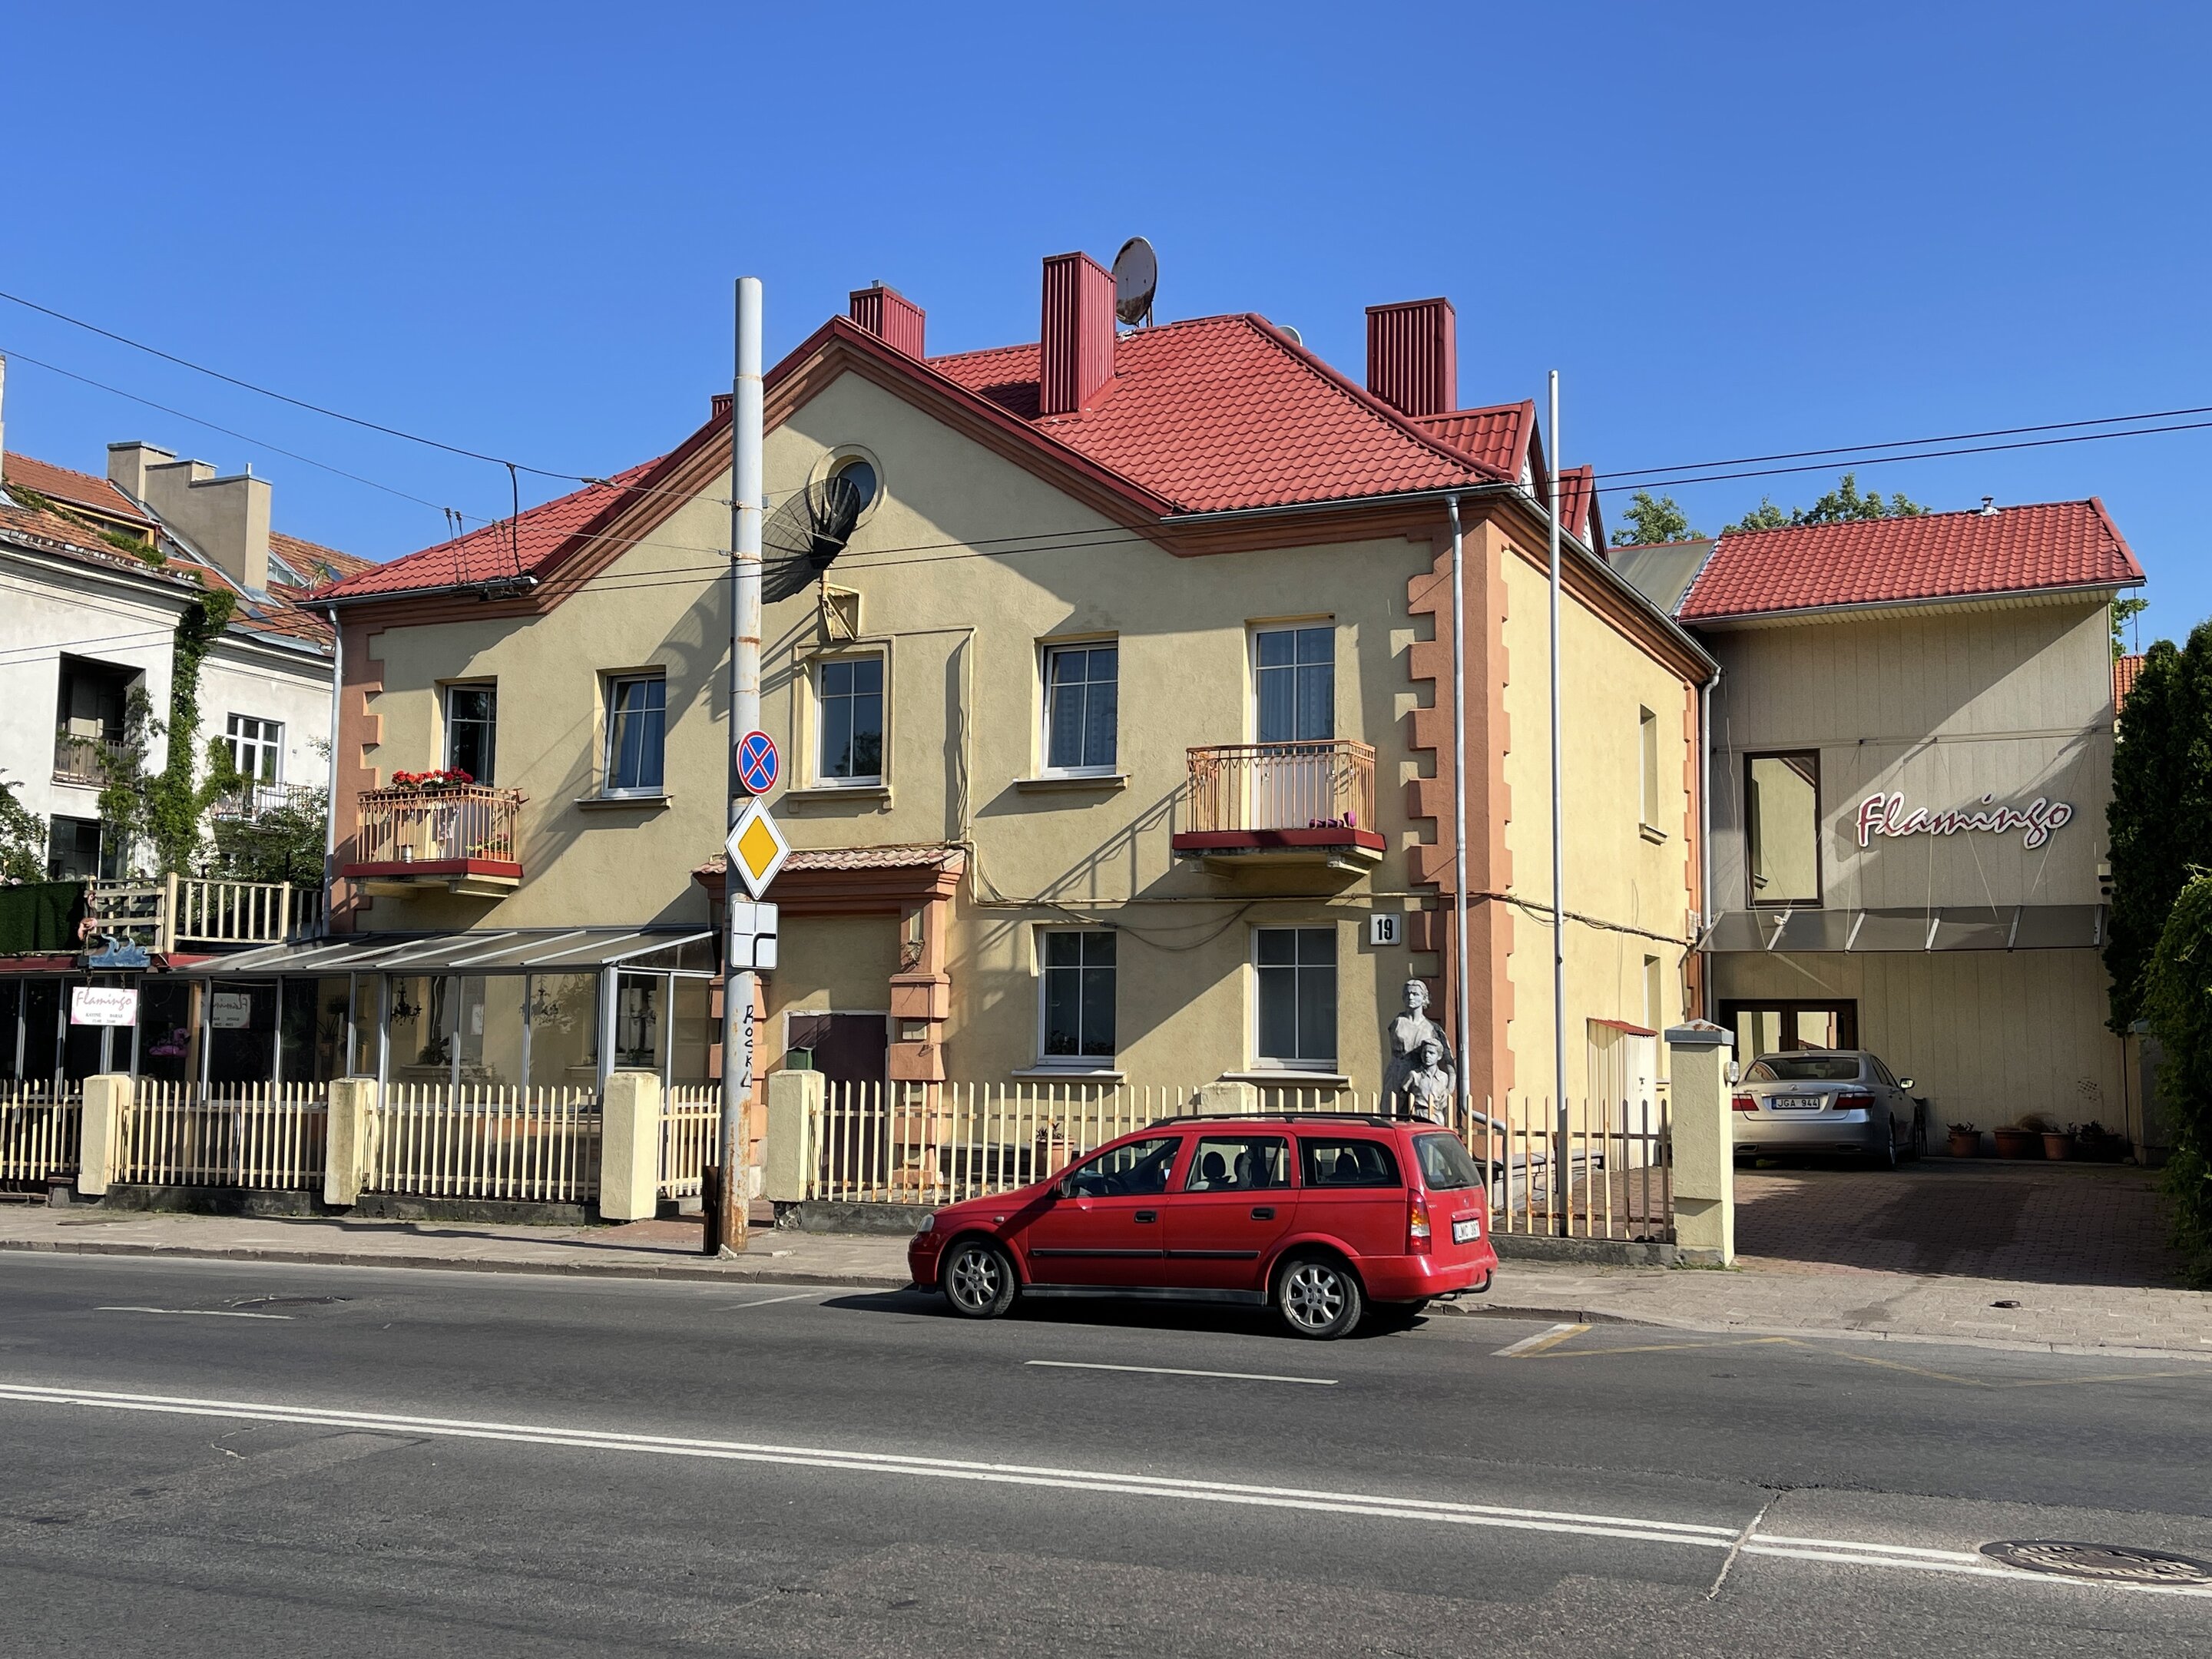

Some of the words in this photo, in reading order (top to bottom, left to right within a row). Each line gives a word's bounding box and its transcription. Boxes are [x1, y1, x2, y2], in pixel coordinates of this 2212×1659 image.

[1856, 791, 2073, 850] Flamingo
[1377, 919, 1393, 941] 19
[76, 988, 132, 1012] Flamingo
[1777, 1099, 1796, 1108] JGA
